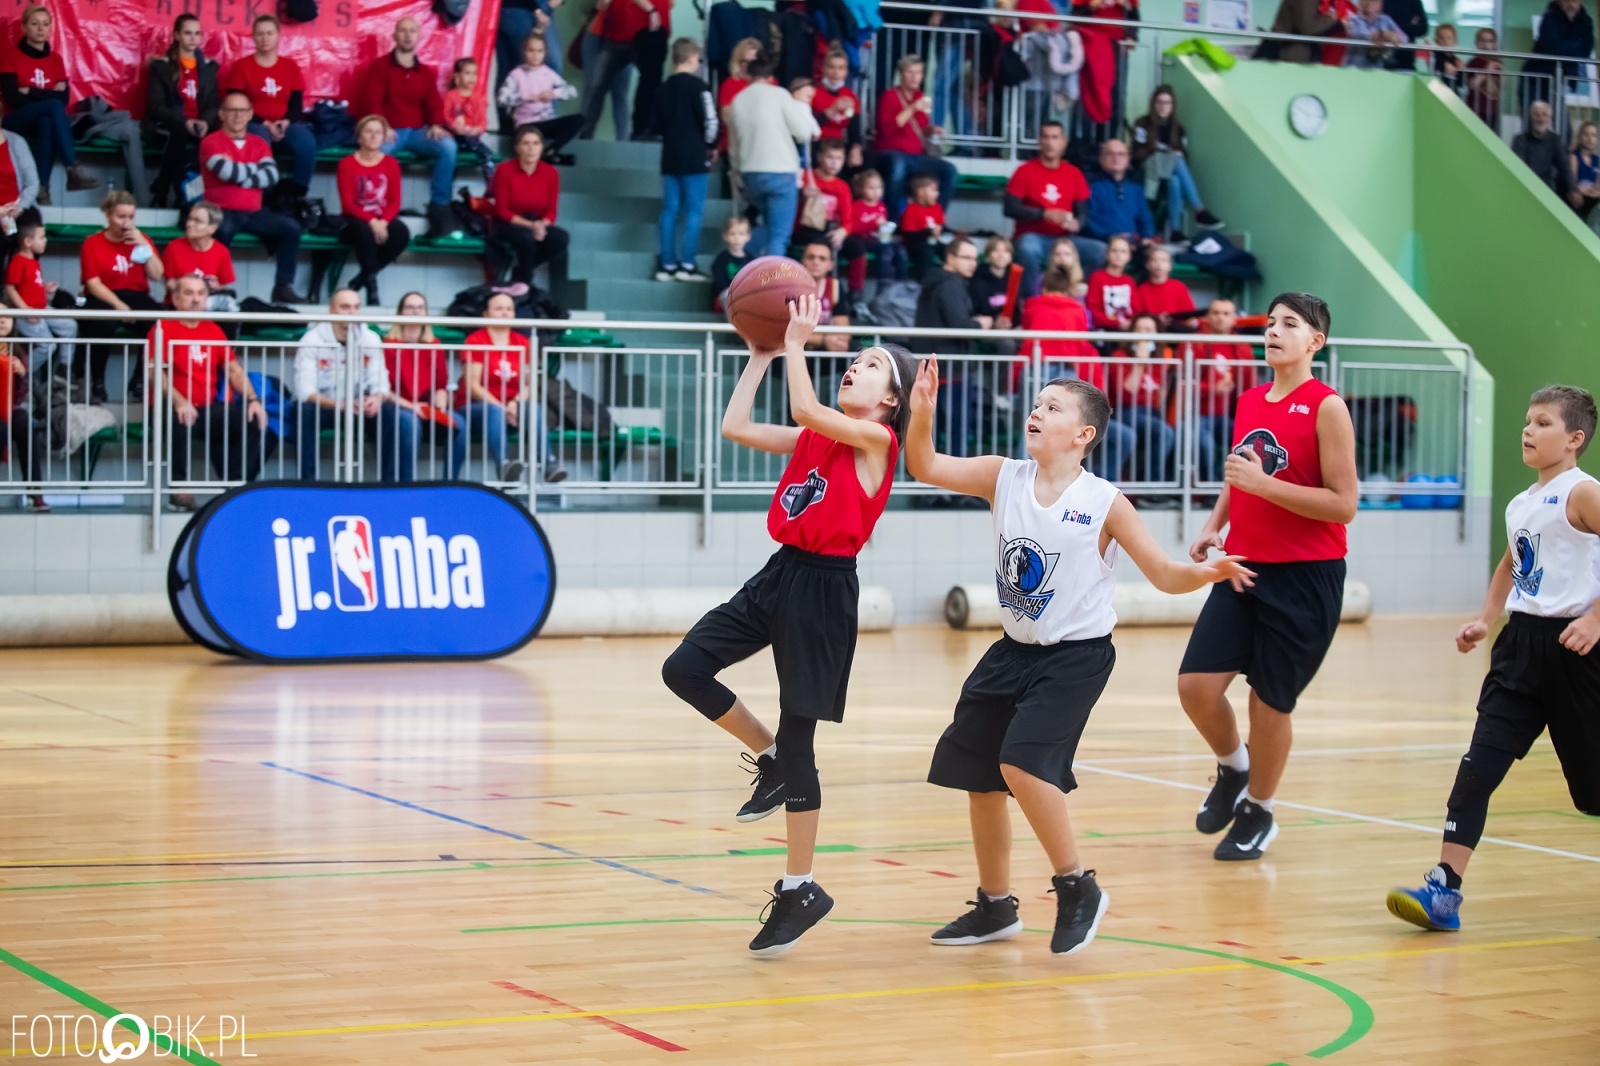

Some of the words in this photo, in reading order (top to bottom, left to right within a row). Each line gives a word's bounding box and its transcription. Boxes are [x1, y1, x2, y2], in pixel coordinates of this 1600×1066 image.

[157, 0, 352, 27] ROCKES
[1076, 512, 1091, 525] nba
[271, 517, 332, 630] jr.
[379, 516, 485, 609] nba
